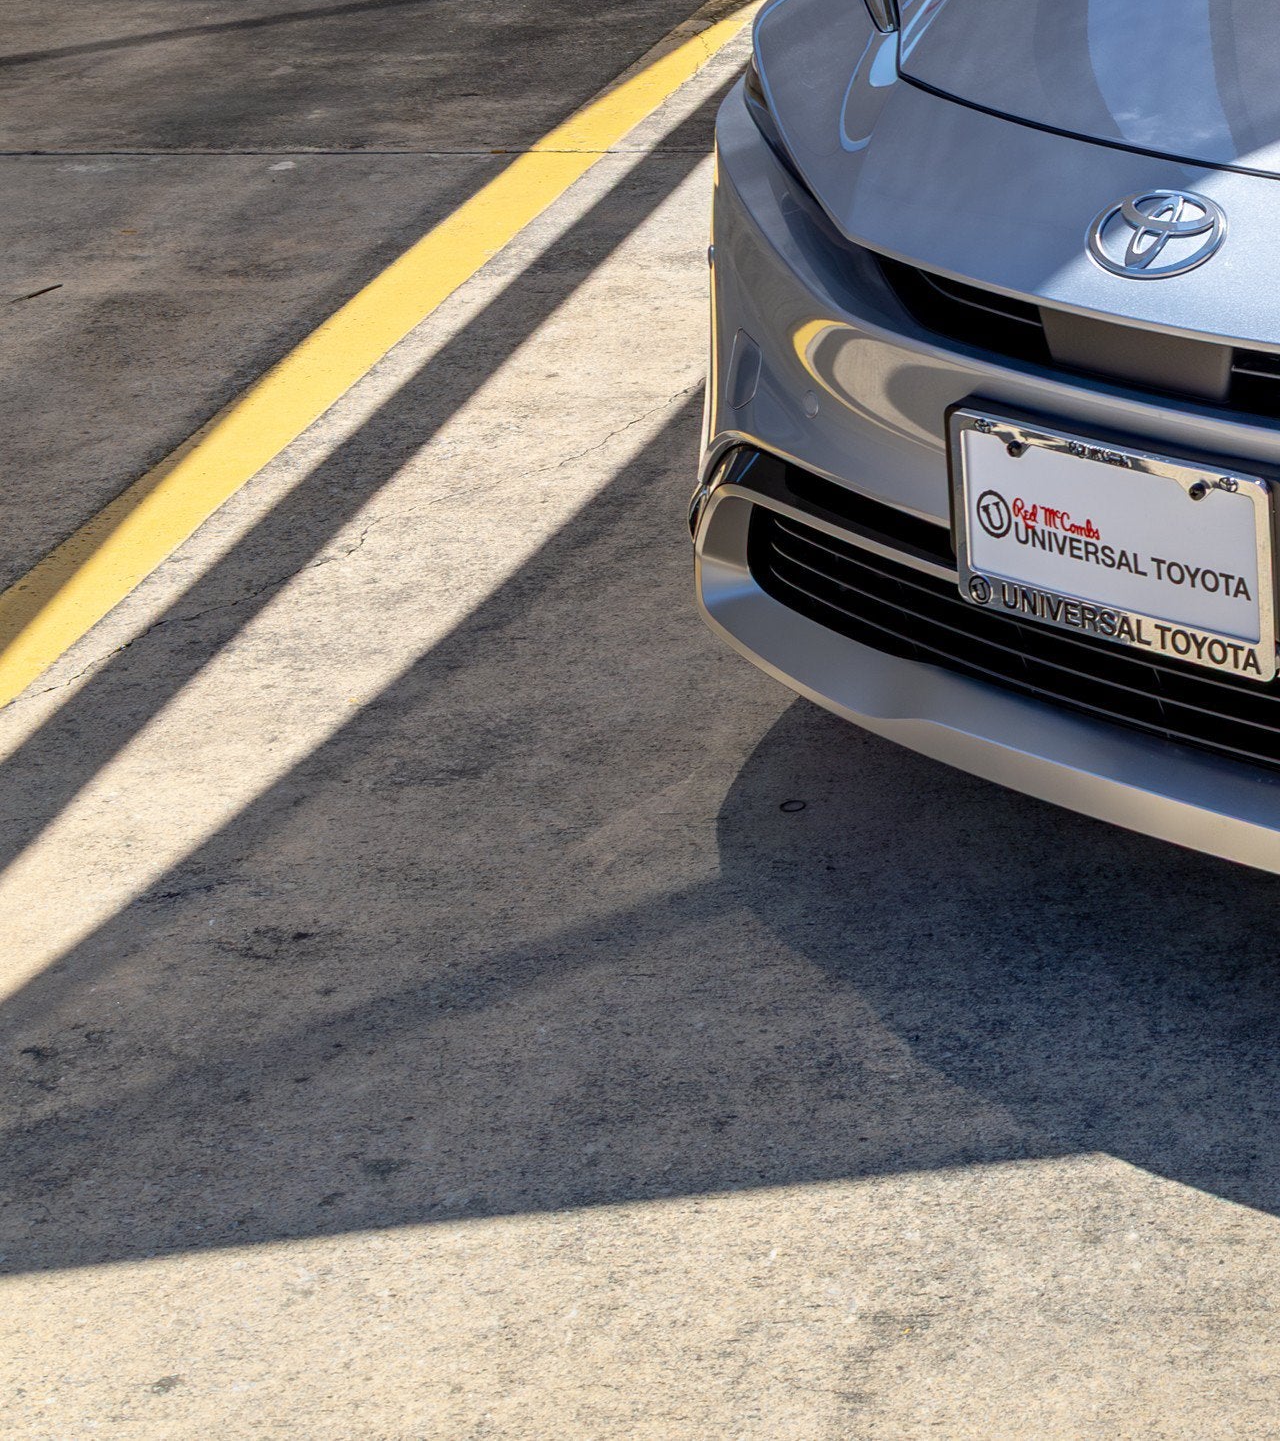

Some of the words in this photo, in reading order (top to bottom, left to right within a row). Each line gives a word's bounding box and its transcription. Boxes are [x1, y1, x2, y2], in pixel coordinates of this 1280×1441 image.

[1013, 498, 1039, 529] Red
[1040, 505, 1100, 540] McCombs
[1015, 521, 1148, 576] UNIVERSAL
[1151, 557, 1251, 601] TOYOTA
[1002, 582, 1152, 645] UNIVERSAL
[1154, 624, 1261, 675] TOYOTA
